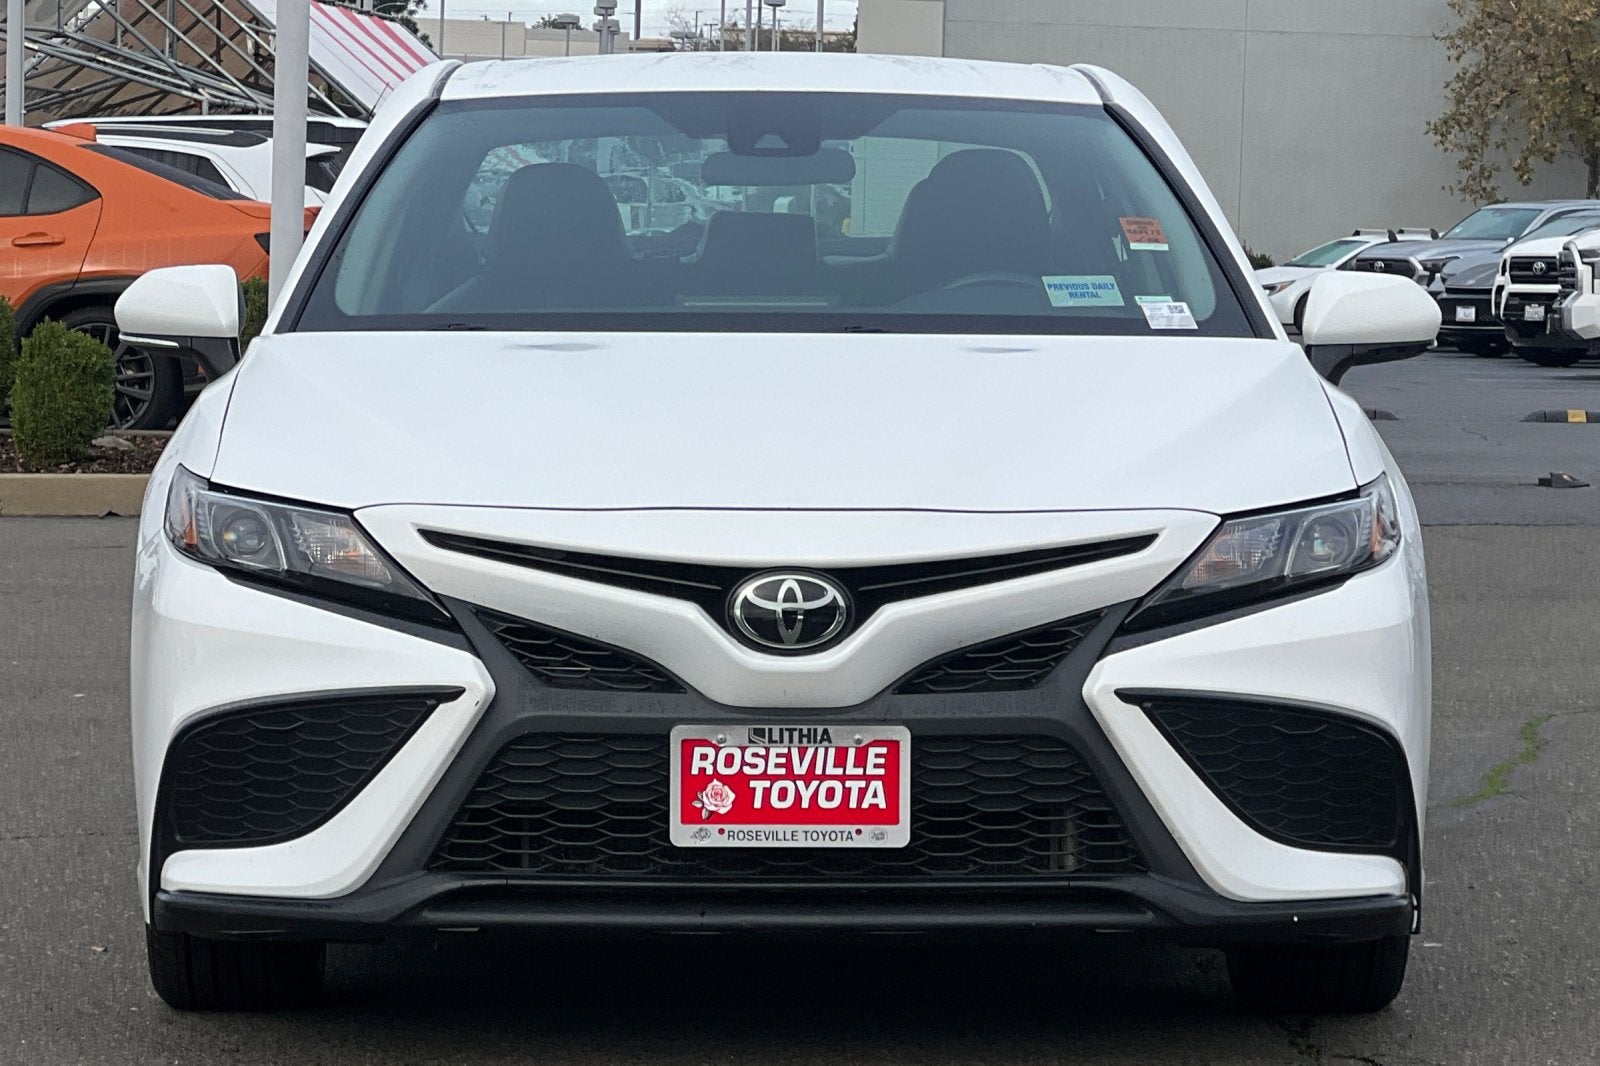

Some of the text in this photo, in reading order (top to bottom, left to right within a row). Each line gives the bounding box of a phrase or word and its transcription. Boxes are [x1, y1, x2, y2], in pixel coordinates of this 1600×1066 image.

[1047, 282, 1116, 291] PREVIOUS DAILY
[1068, 291, 1102, 299] RENTAL
[768, 728, 833, 744] LITHIA
[691, 746, 888, 776] ROSEVILLE
[750, 780, 888, 810] TOYOTA
[727, 830, 854, 842] ROSEVILLE TOYOTA
